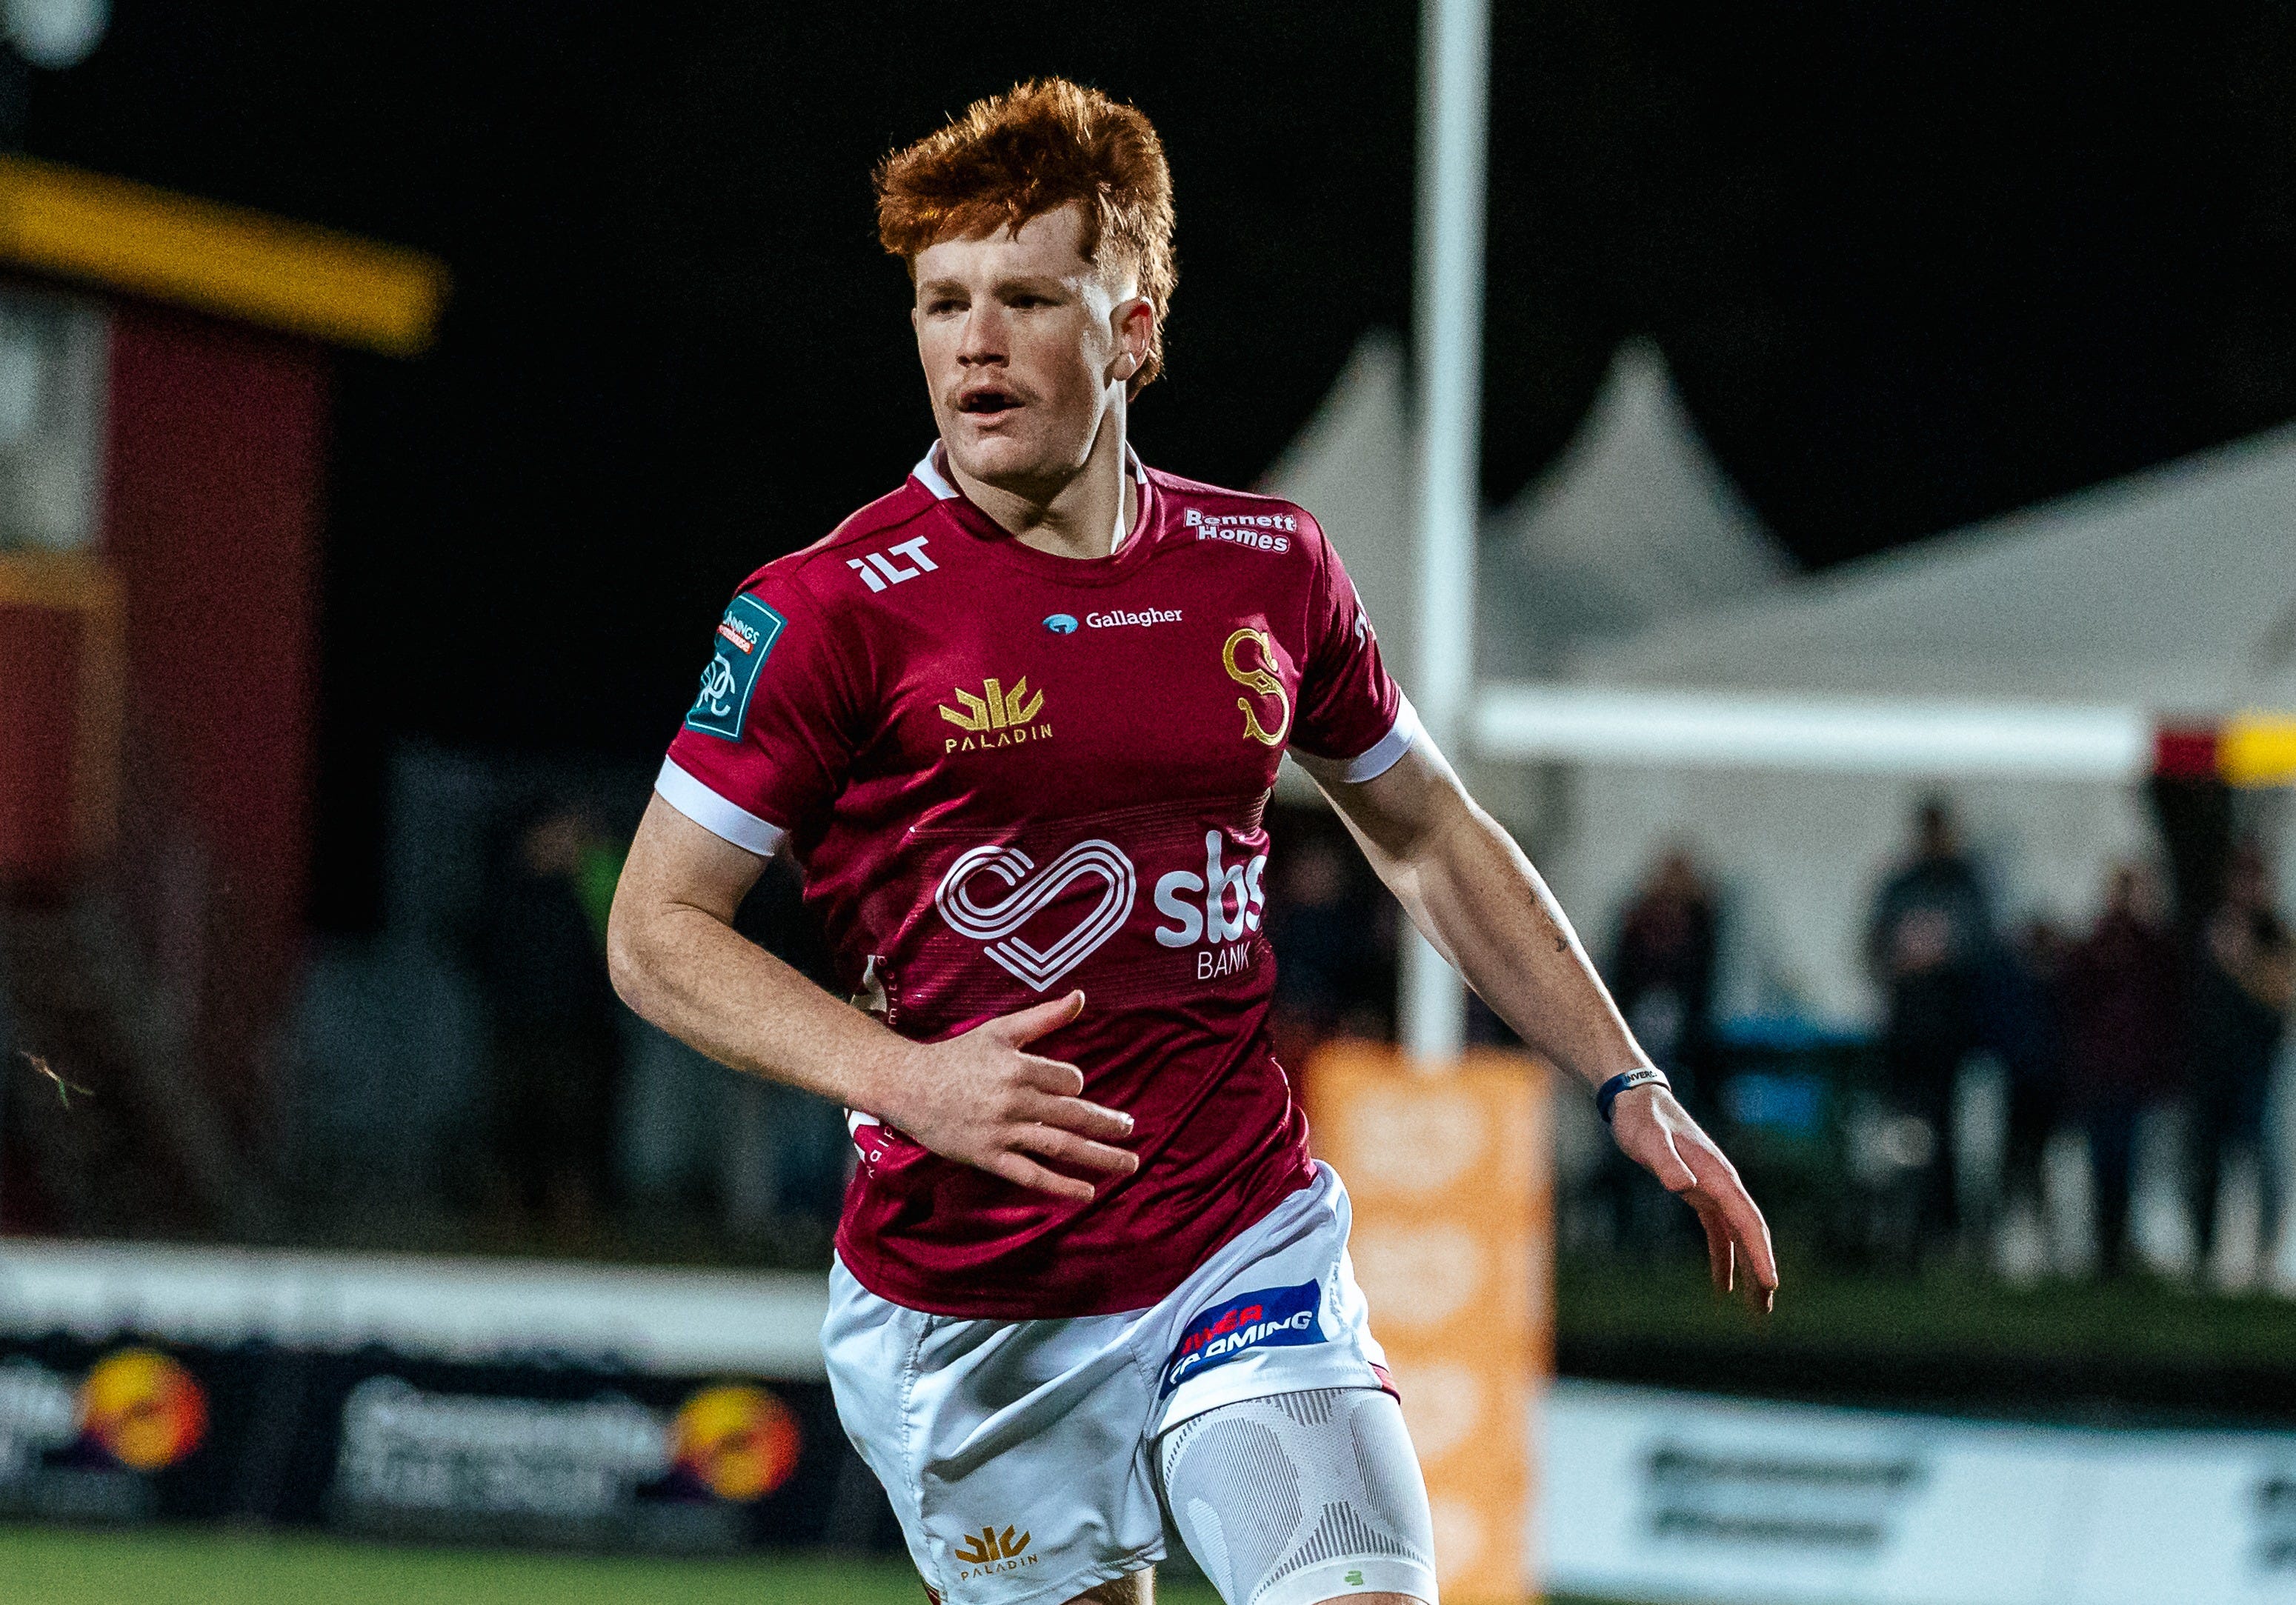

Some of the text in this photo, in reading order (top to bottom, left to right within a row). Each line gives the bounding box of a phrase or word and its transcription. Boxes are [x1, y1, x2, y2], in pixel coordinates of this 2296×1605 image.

[1185, 509, 1297, 532] Bennett
[1198, 525, 1288, 552] Homes
[1085, 607, 1183, 629] Gallagher
[945, 723, 1054, 754] PALADIN
[1154, 830, 1265, 948] sbs
[1197, 941, 1251, 980] BANK
[960, 1553, 1039, 1581] PALADIN
